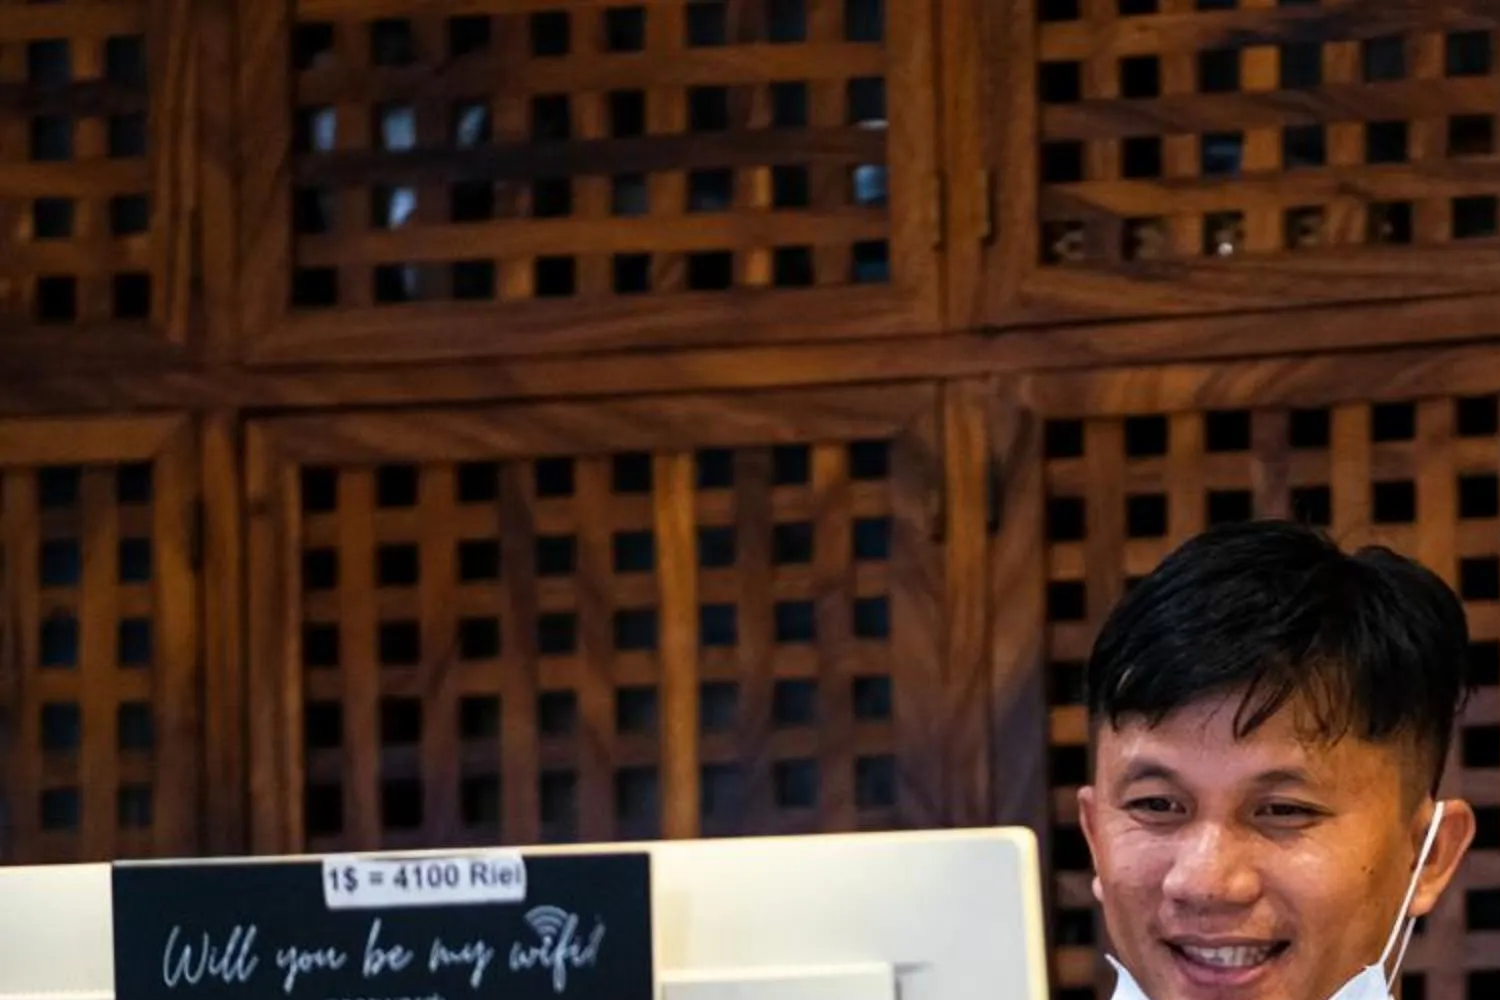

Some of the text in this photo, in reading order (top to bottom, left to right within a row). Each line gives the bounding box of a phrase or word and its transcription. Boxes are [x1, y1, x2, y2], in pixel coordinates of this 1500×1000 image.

[328, 862, 521, 893] 1$ = 4100 Riel
[162, 924, 260, 988] Will
[275, 945, 347, 994] you
[363, 917, 414, 978] be
[427, 937, 494, 989] my
